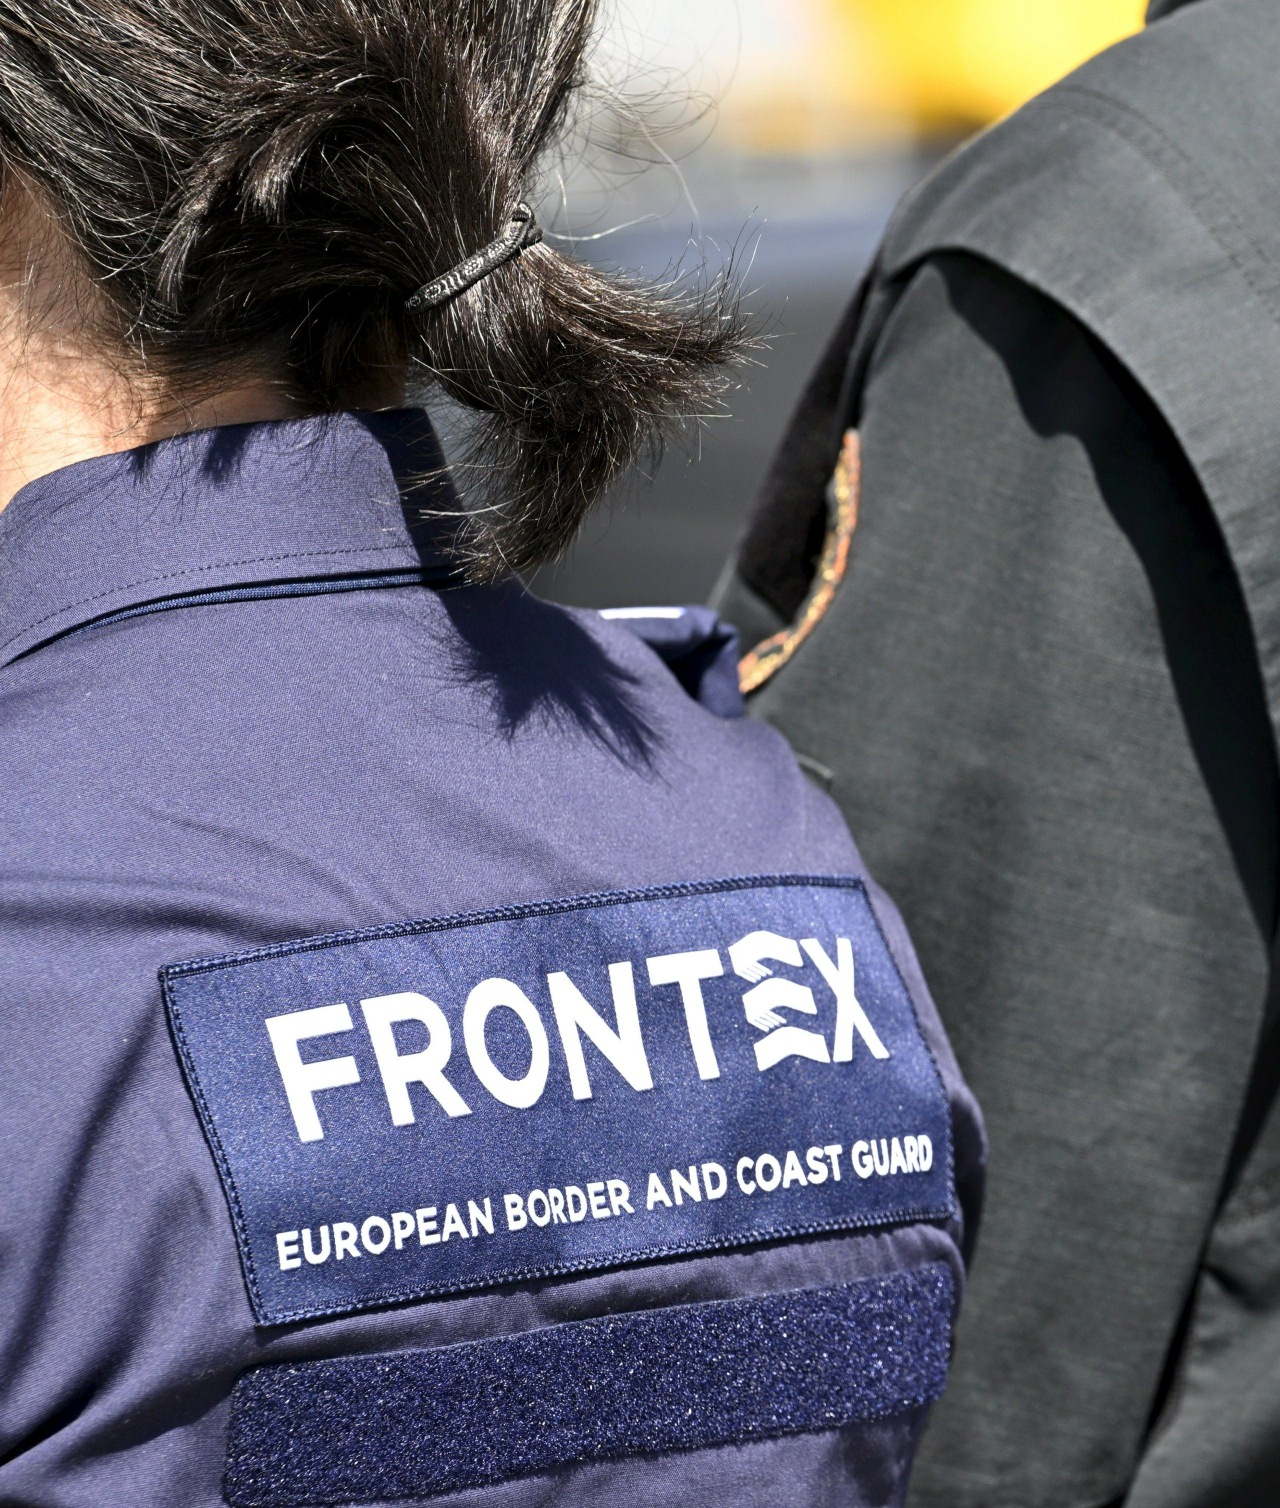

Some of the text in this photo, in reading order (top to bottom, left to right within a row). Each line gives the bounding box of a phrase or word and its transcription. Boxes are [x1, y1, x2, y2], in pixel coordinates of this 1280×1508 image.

[264, 929, 891, 1144] FRONTEX
[275, 1133, 934, 1272] EUROPEAN BORDER AND COAST GUARD
